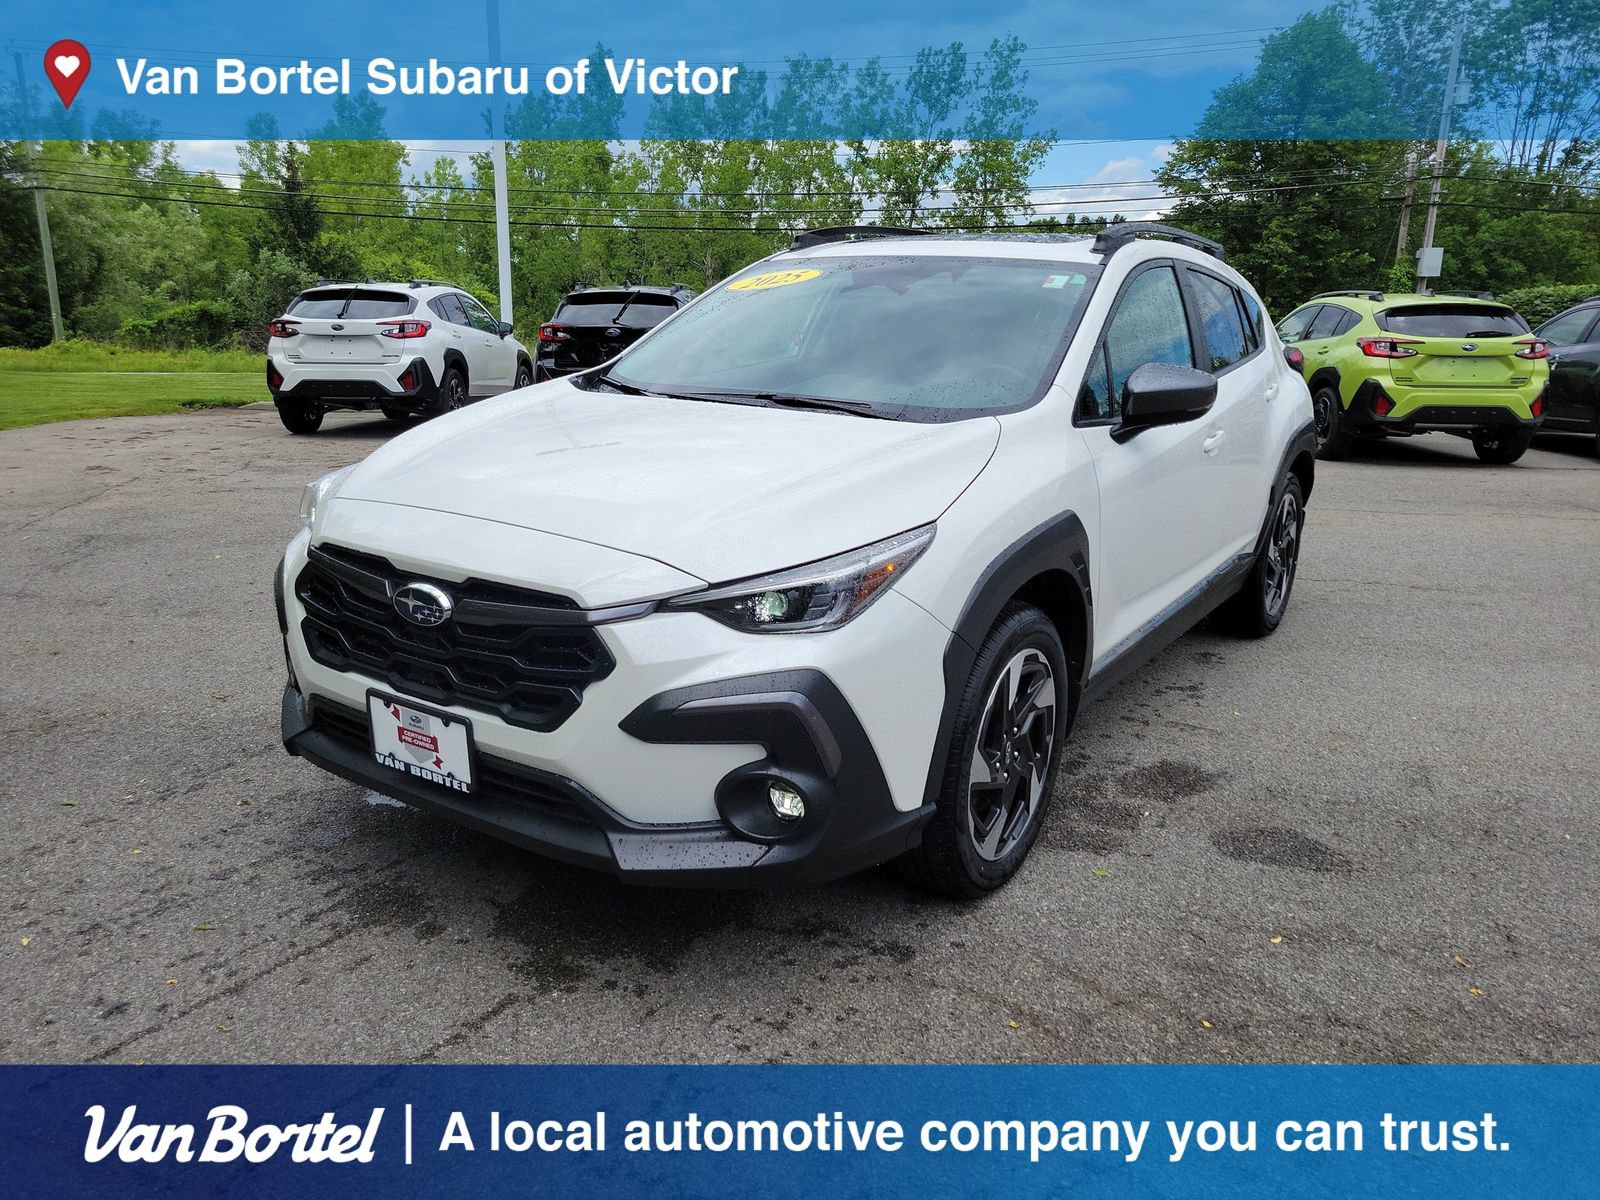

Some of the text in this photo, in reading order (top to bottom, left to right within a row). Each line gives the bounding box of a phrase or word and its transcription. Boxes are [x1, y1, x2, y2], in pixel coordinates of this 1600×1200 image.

[740, 270, 811, 289] 2025
[401, 734, 435, 750] PRE-OWNED
[403, 730, 432, 743] CERTIFIED
[375, 752, 471, 794] VAN BORTEL
